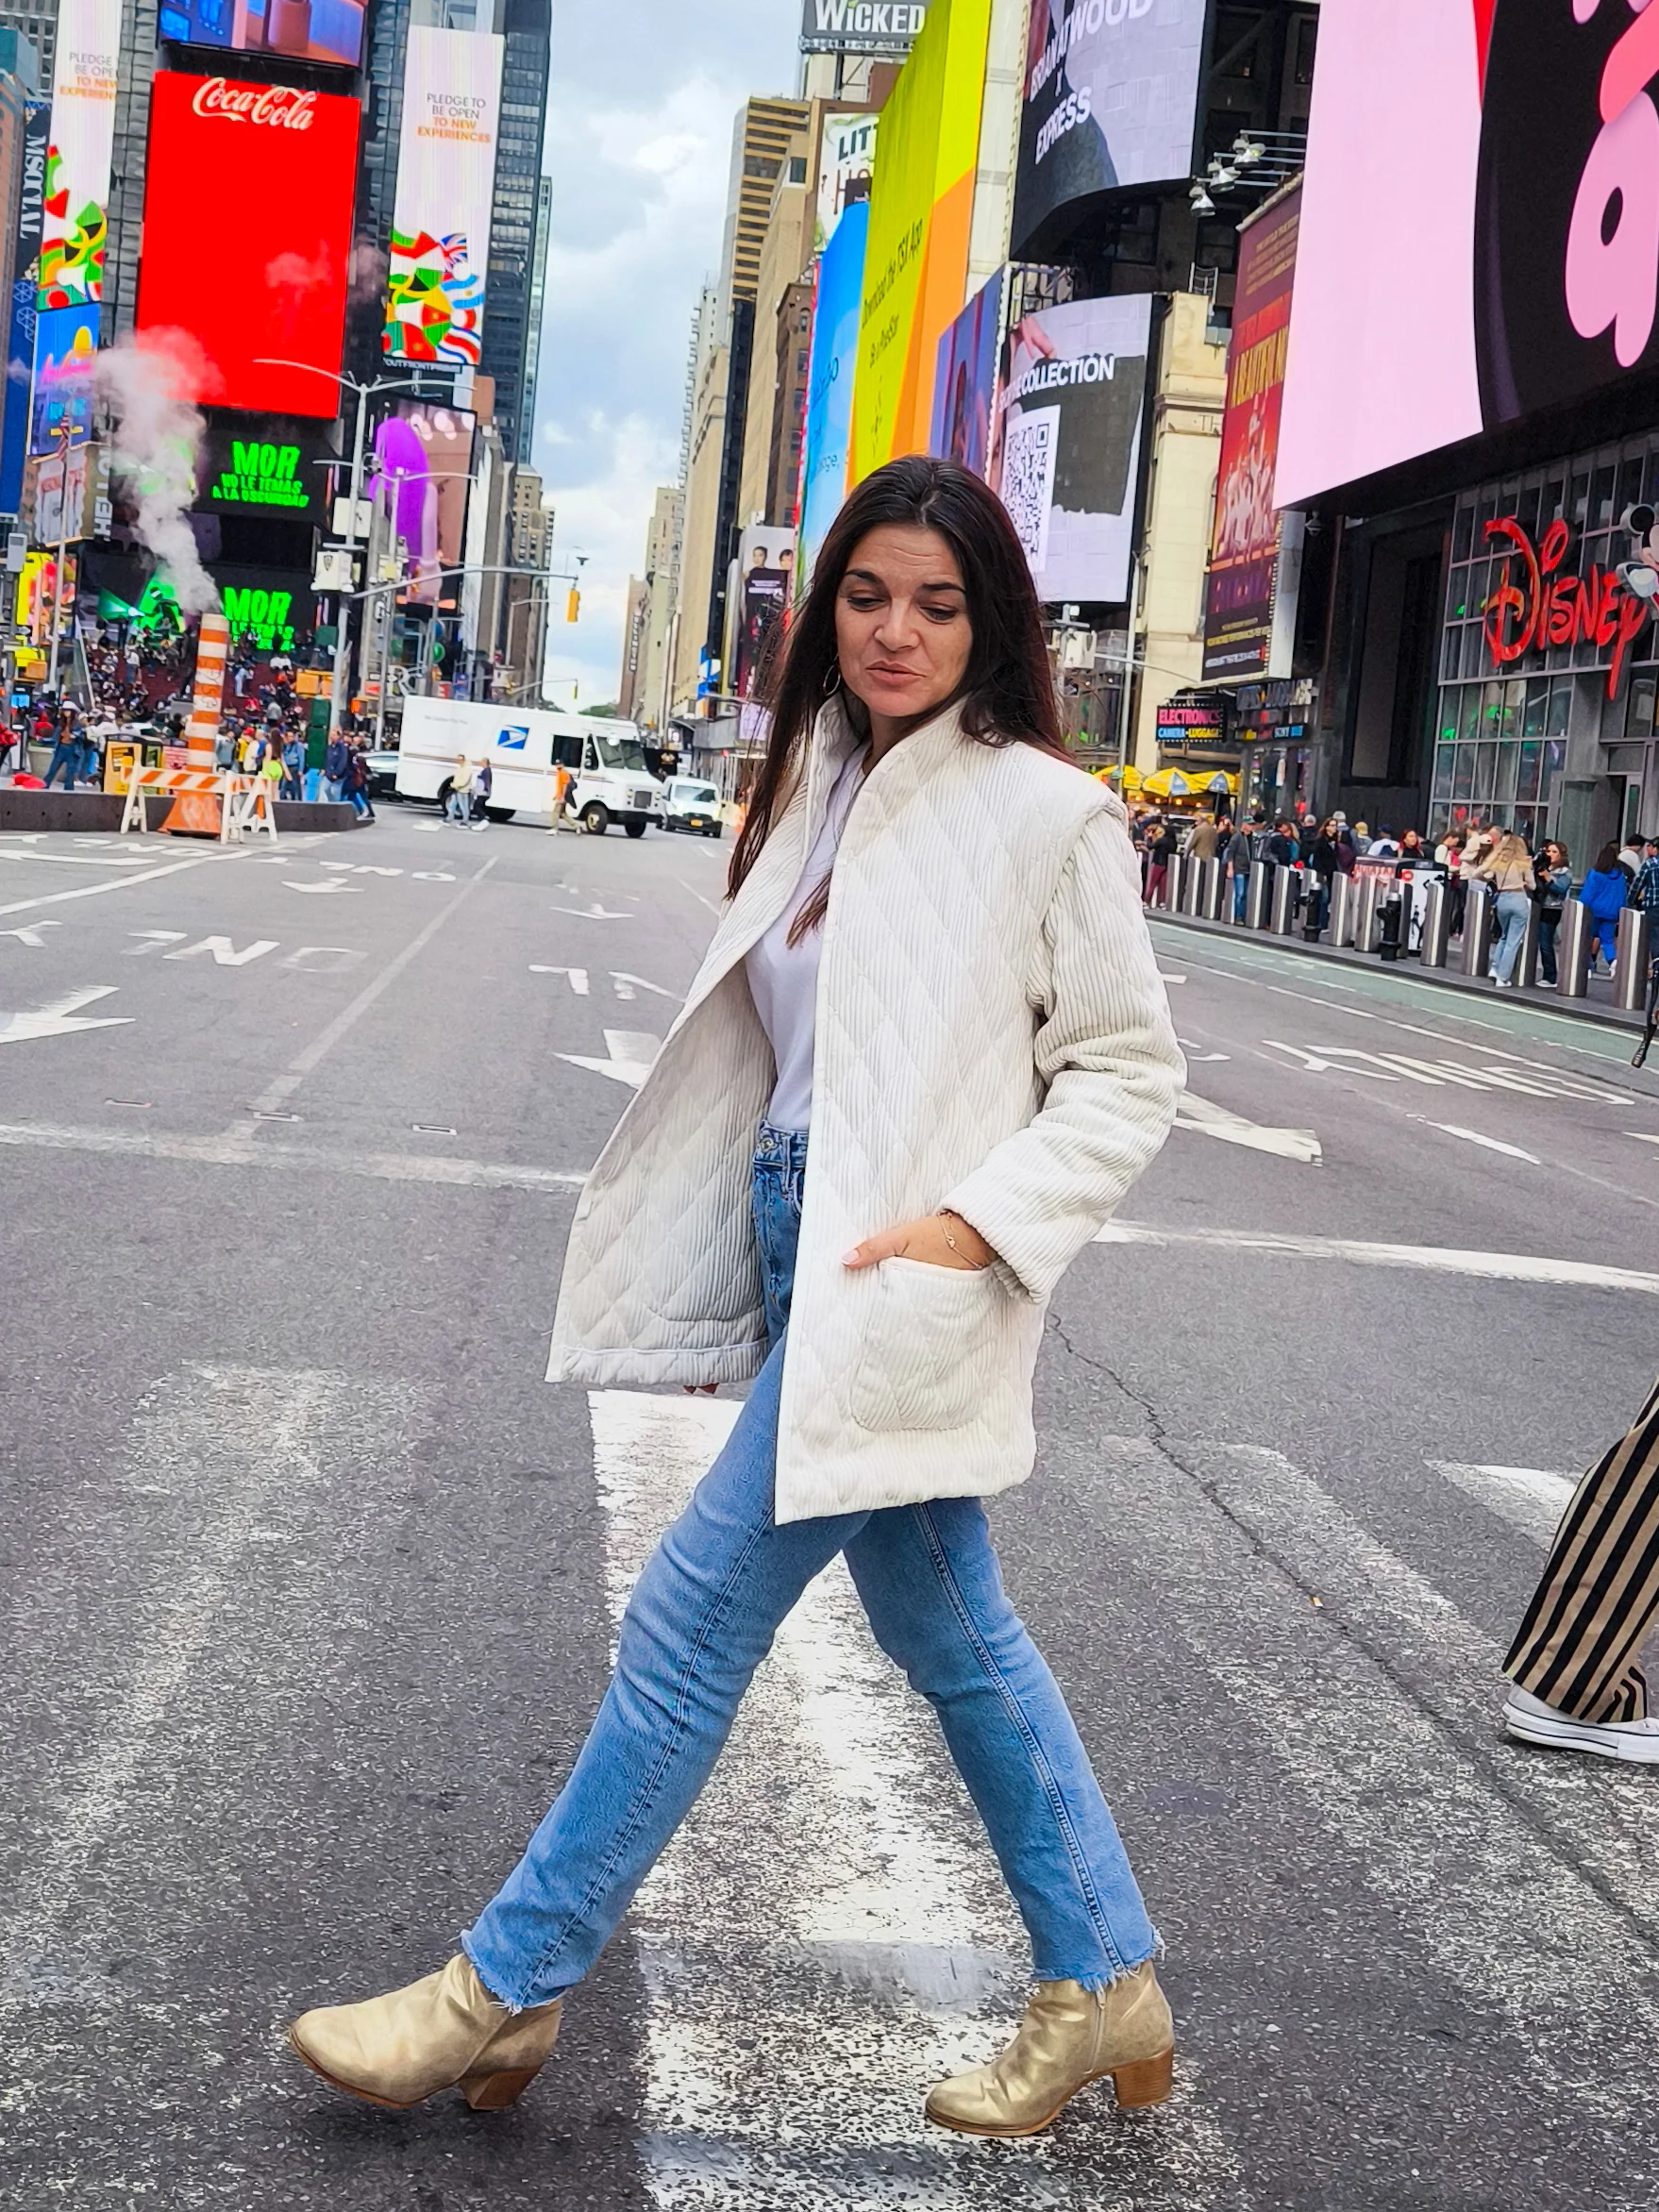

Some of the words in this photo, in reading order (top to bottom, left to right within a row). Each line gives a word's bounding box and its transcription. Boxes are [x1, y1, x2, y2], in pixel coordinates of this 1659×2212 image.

[69, 51, 112, 66] PLEDGE
[75, 65, 87, 75] BE
[91, 67, 115, 78] OPE
[76, 75, 91, 87] TO
[59, 86, 115, 101] EXPERIEN
[427, 92, 470, 107] PLEDGE
[472, 96, 486, 109] TO
[192, 77, 317, 131] Coca-Cola
[432, 106, 444, 115] BE
[448, 108, 479, 120] OPEN
[434, 116, 448, 127] TO
[452, 120, 477, 130] NEW
[1035, 86, 1093, 165] EXPRESS
[416, 126, 491, 143] EXPERIENCES
[1020, 355, 1114, 396] COLLECTION
[232, 441, 301, 479] MOR
[212, 484, 223, 499] A
[224, 487, 240, 500] LA
[225, 586, 293, 625] MOR
[1159, 708, 1221, 726] ELECTRONICS
